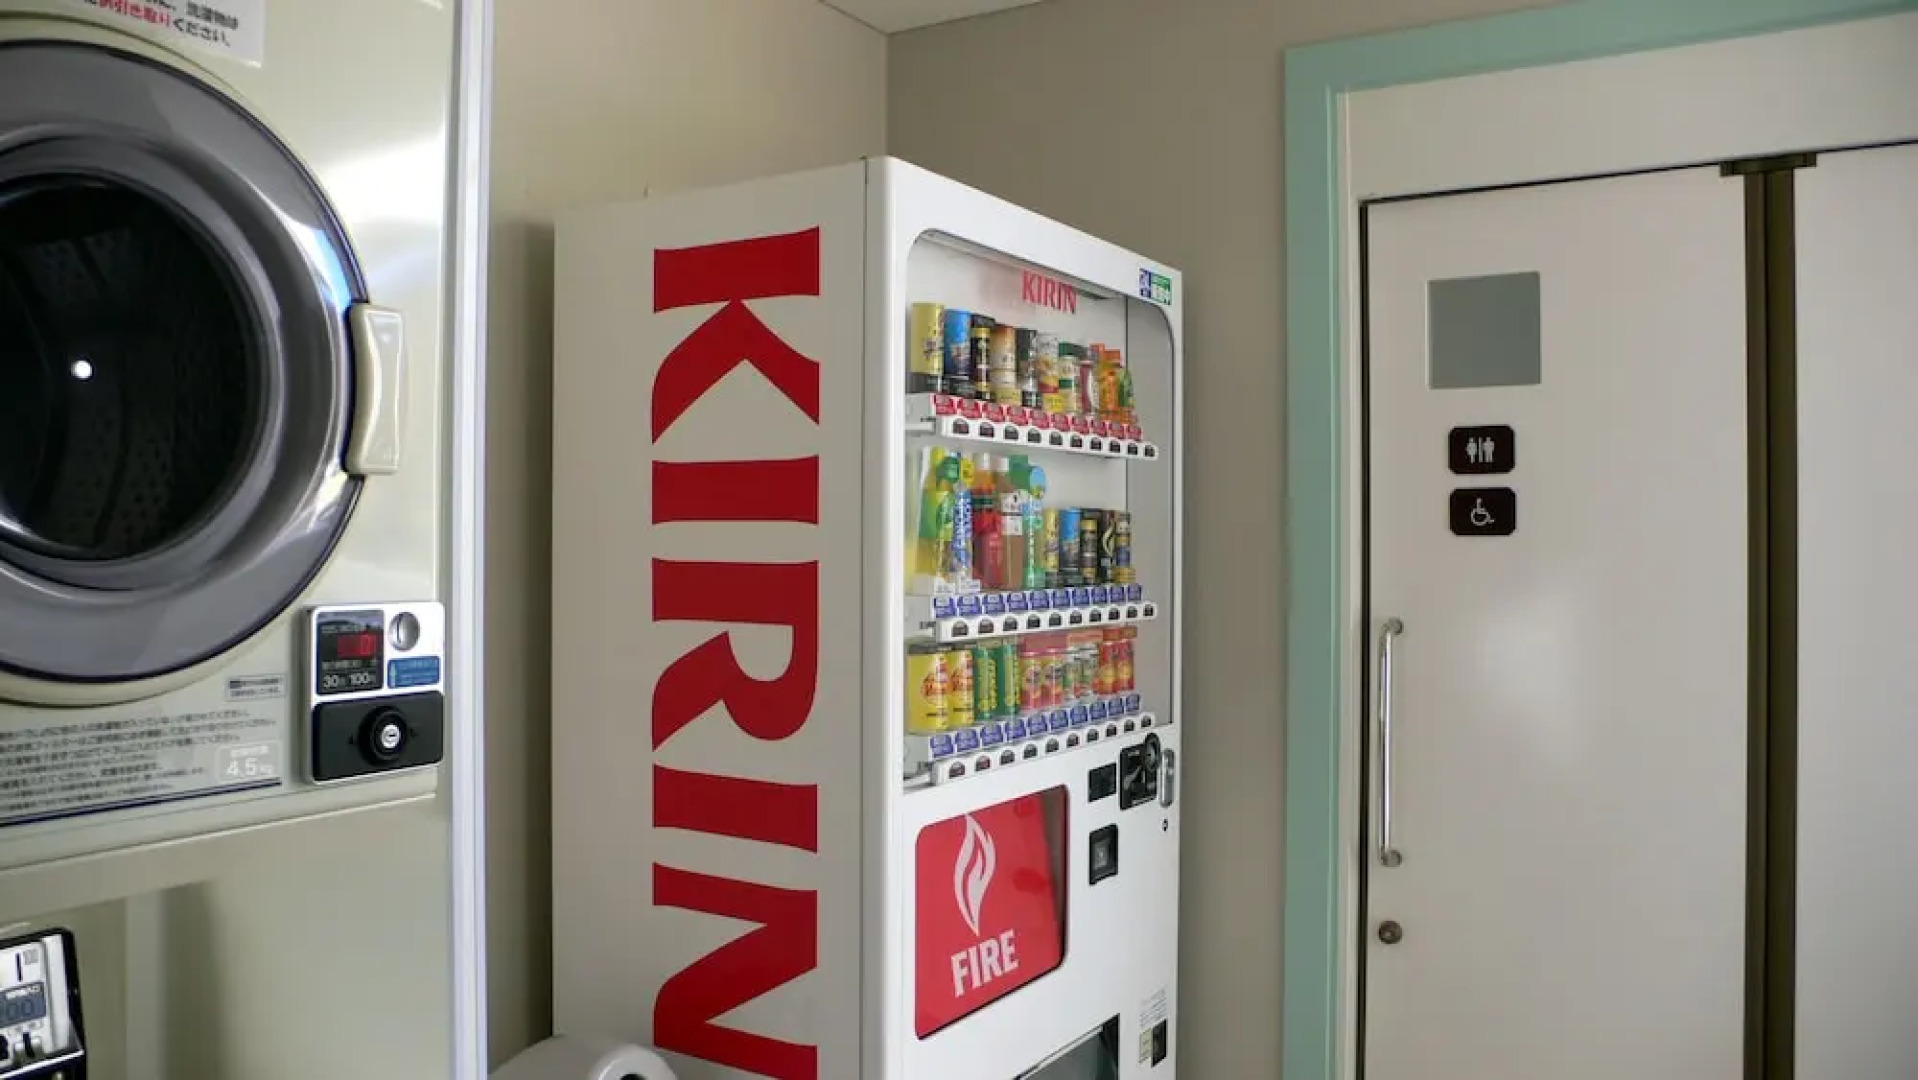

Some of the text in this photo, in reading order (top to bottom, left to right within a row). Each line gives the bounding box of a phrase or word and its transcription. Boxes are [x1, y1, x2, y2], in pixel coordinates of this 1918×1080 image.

[1021, 269, 1078, 314] KIRIN
[652, 226, 820, 1080] KIRIN
[950, 929, 1020, 998] FIRE
